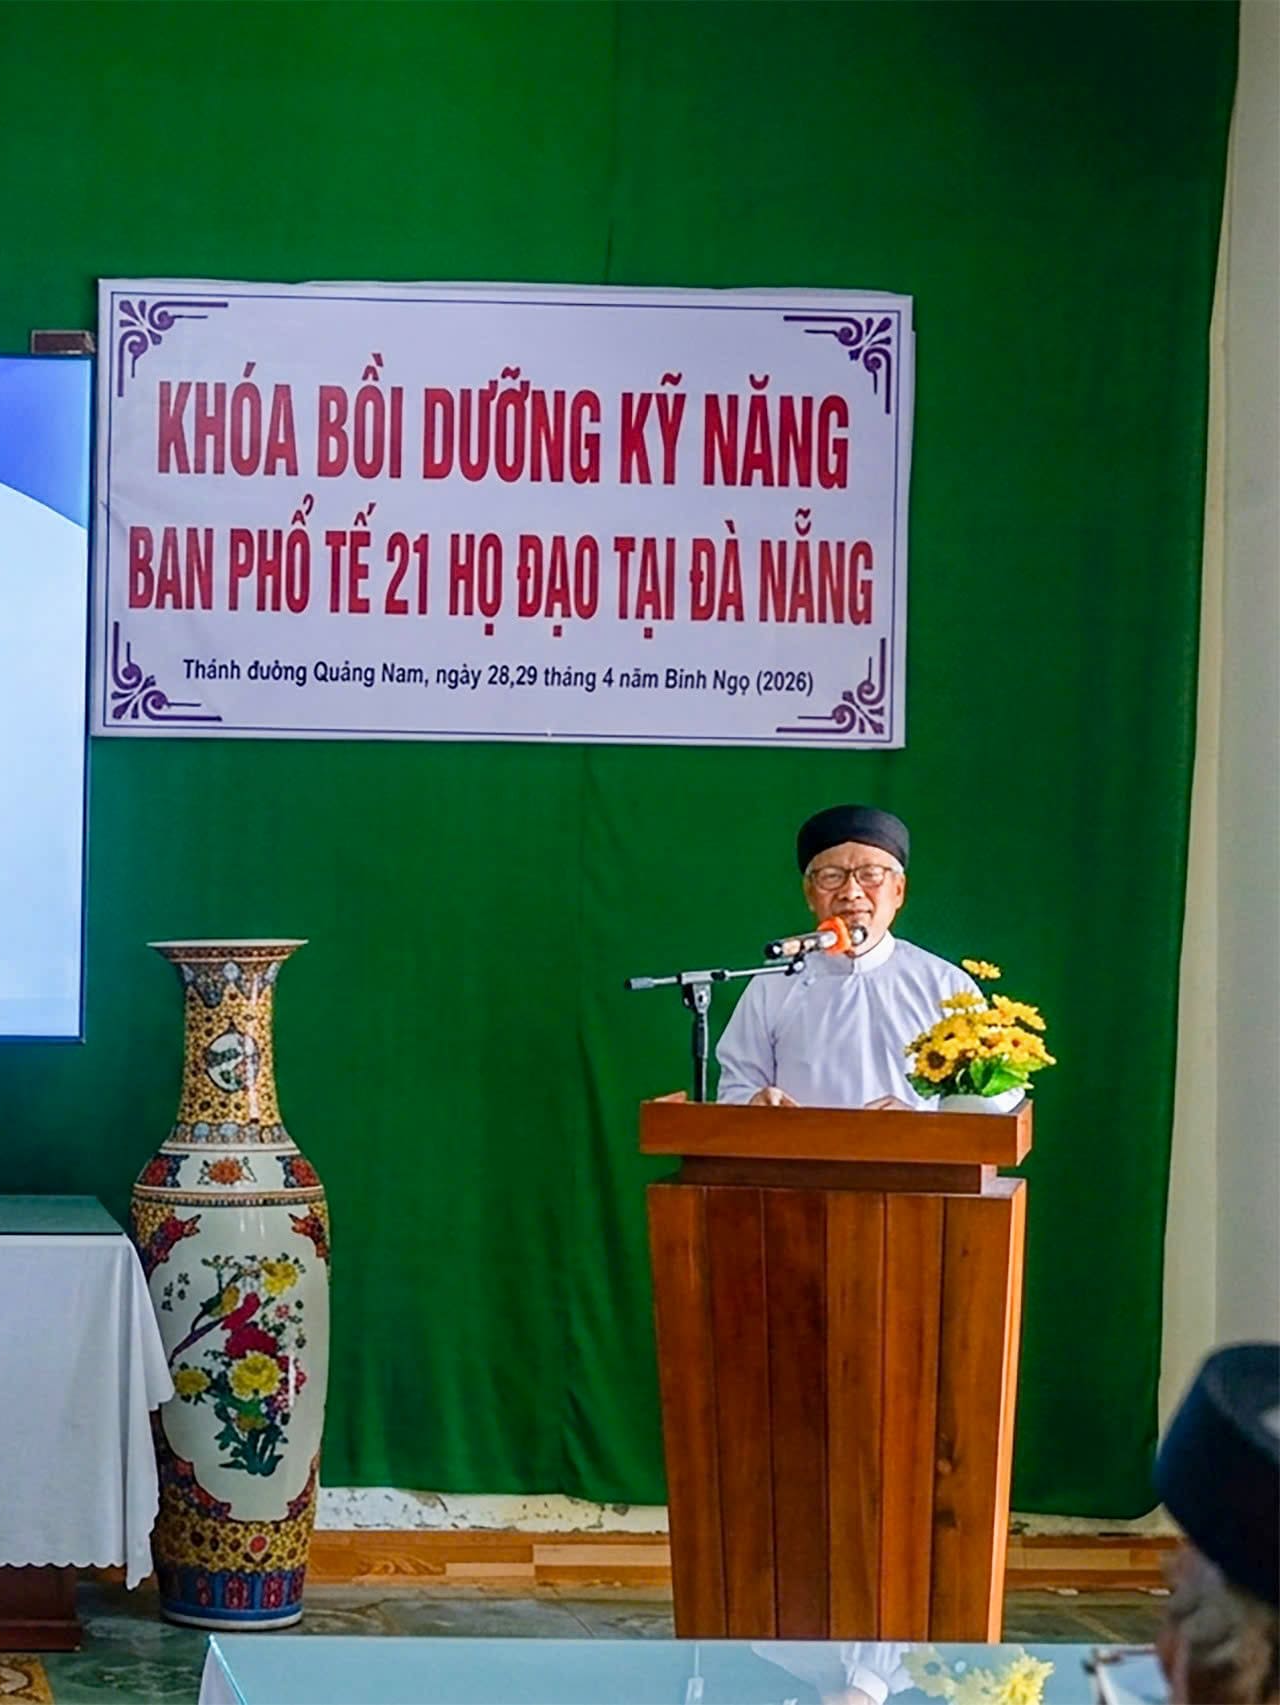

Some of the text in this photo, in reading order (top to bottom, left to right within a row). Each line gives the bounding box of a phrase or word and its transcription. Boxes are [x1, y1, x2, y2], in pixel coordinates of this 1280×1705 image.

[158, 353, 848, 489] KHÓA BỒI DƯỠNG KỸ NĂNG
[129, 494, 873, 639] BAN PHỔ TẾ 21 HỌ ĐẠO TẠI ĐÀ NẴNG
[183, 659, 240, 679] Thánh
[382, 663, 428, 687] Nam,
[488, 665, 537, 688] 28,29
[544, 666, 596, 692] tháng
[603, 668, 614, 687] 4
[620, 668, 658, 688] năm
[713, 670, 750, 695] Ngọ
[757, 671, 813, 696] (2026)
